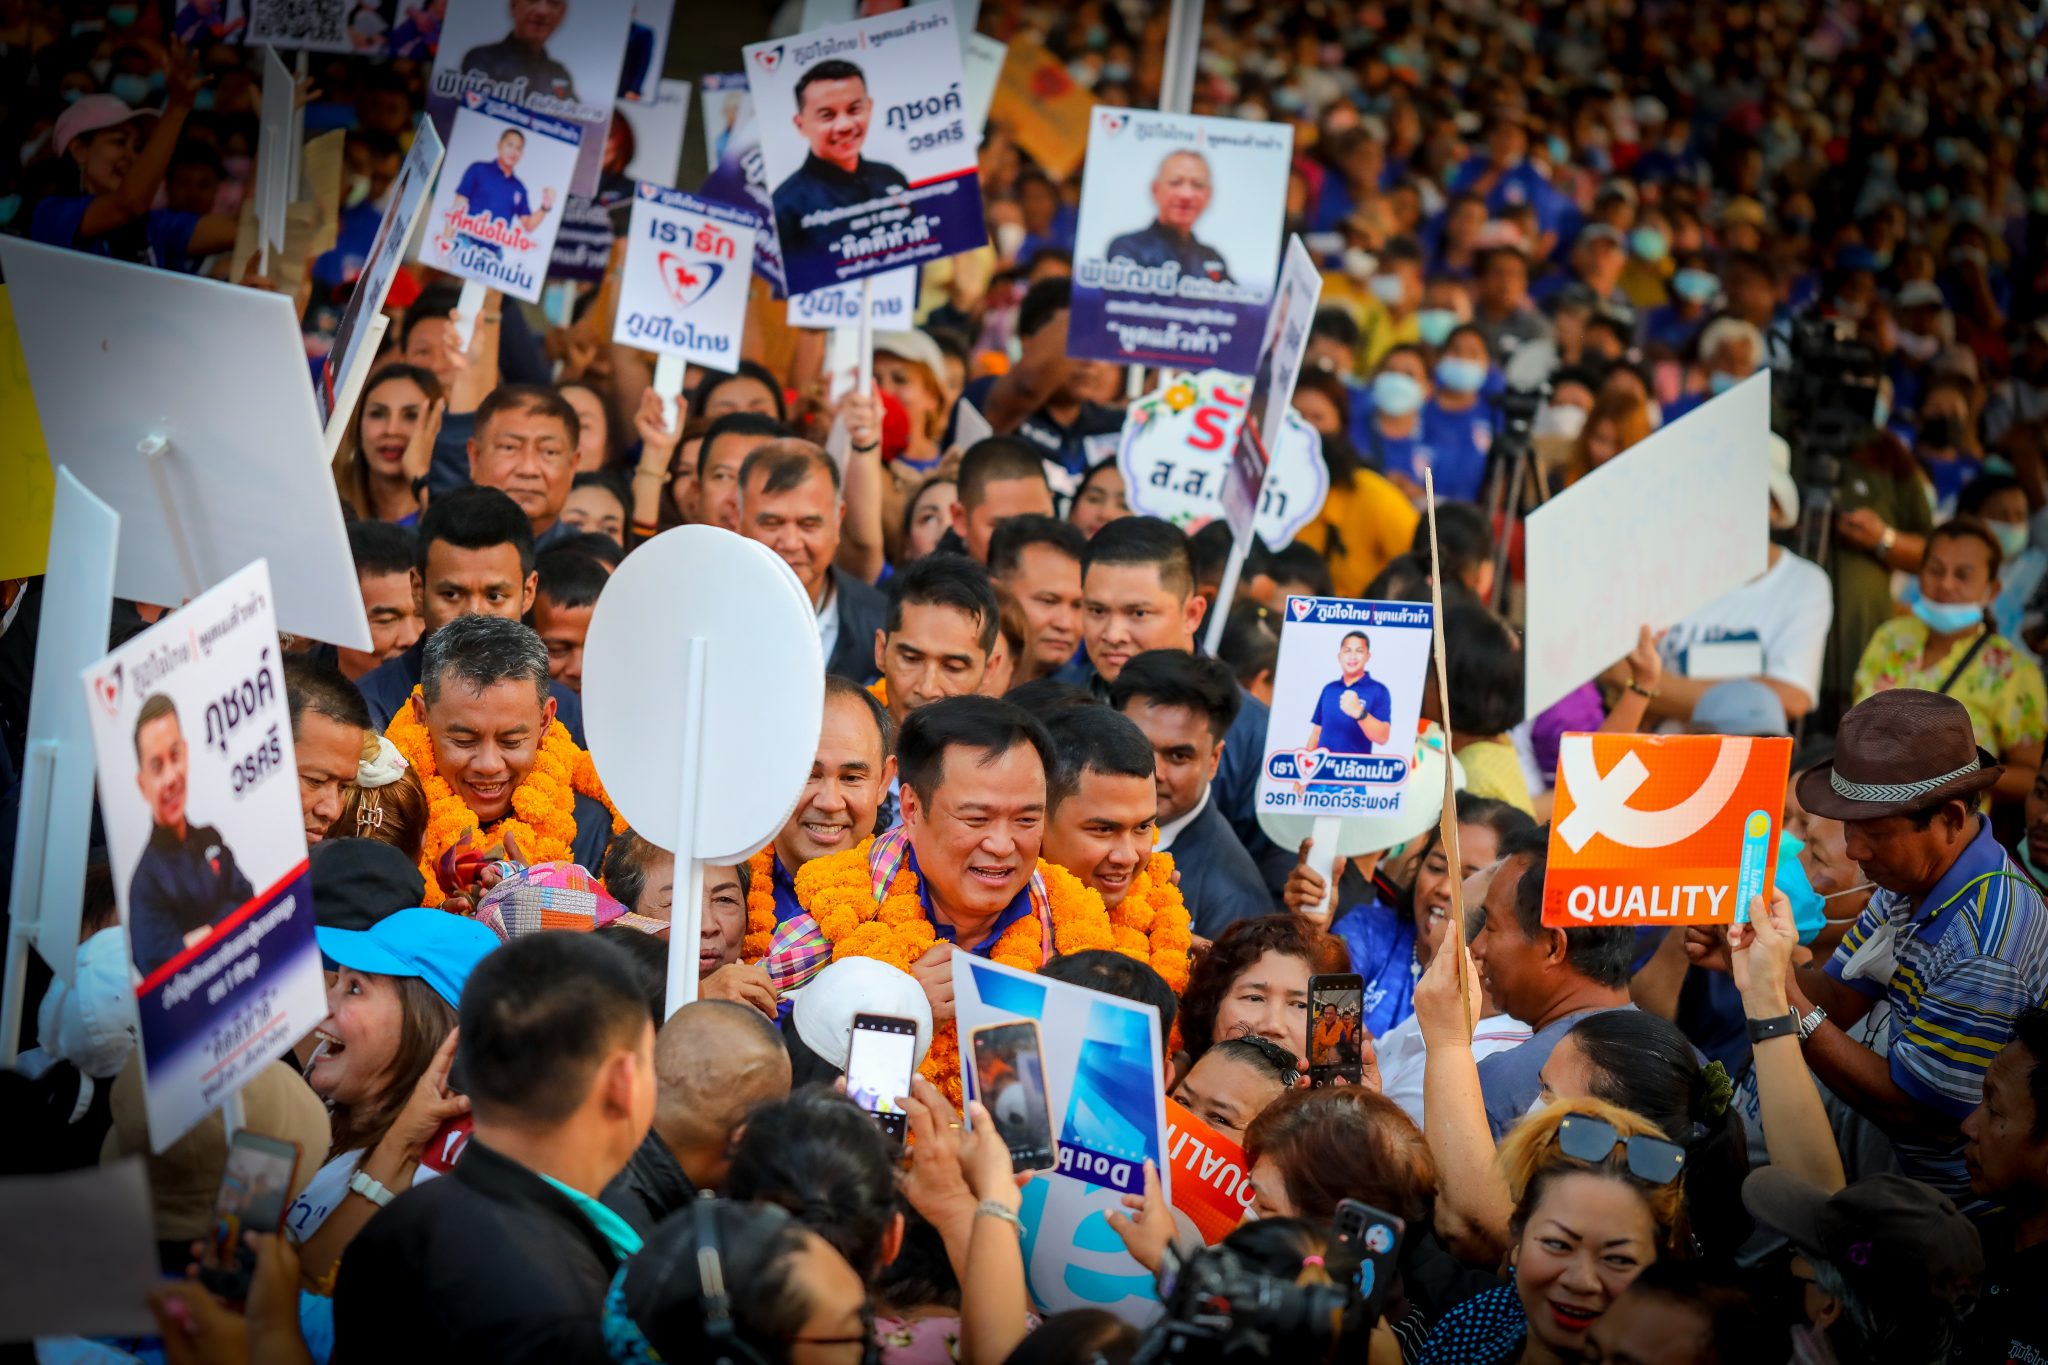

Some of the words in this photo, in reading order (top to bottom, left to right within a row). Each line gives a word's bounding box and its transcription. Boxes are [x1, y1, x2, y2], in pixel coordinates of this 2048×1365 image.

[650, 218, 736, 260] เรารัก
[797, 290, 903, 318] ภูมิใจทย
[625, 312, 730, 352] ภูมิใจไทย
[1316, 603, 1370, 622] ภูมิใจไทย
[1373, 607, 1430, 626] พูดแล้วทำ
[1273, 761, 1294, 776] เรา
[1567, 885, 1729, 922] QUALITY
